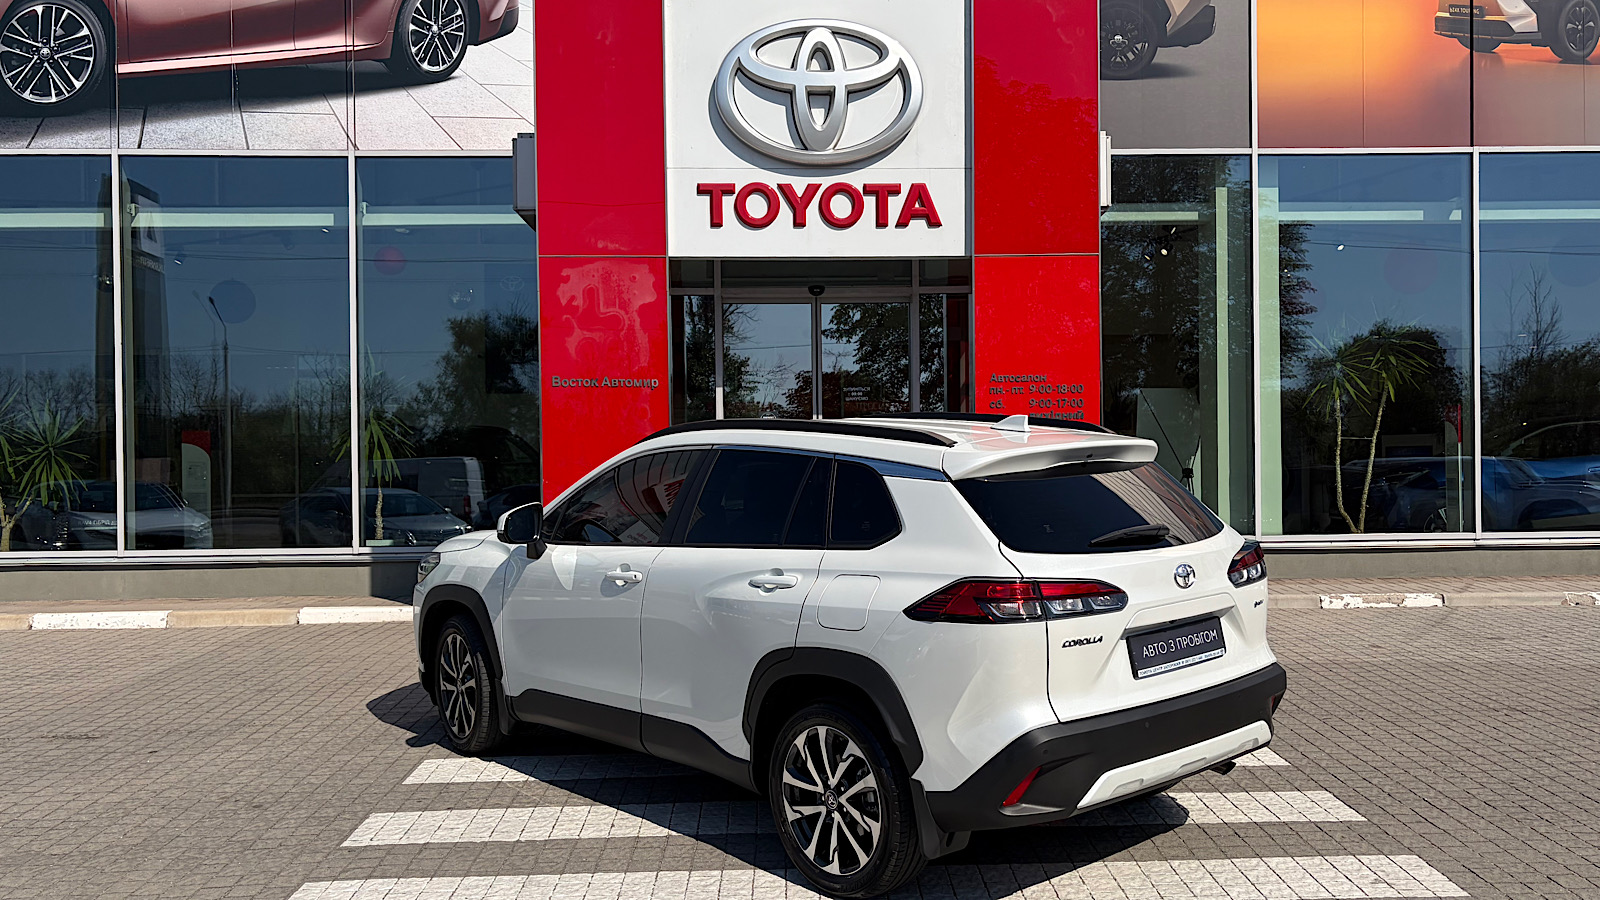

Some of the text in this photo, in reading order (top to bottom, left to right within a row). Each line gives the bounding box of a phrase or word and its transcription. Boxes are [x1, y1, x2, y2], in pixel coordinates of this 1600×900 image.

[697, 182, 943, 231] TOYOTA
[551, 375, 659, 391] Восток Автомир
[989, 373, 1047, 383] Автосалон
[1029, 383, 1084, 394] 9:00-18:00
[989, 398, 1084, 409] сб. 9:00-17:00
[1061, 635, 1103, 648] COROLLA
[1143, 641, 1167, 658] АВТО
[1176, 629, 1218, 650] ПРОБІГОМ
